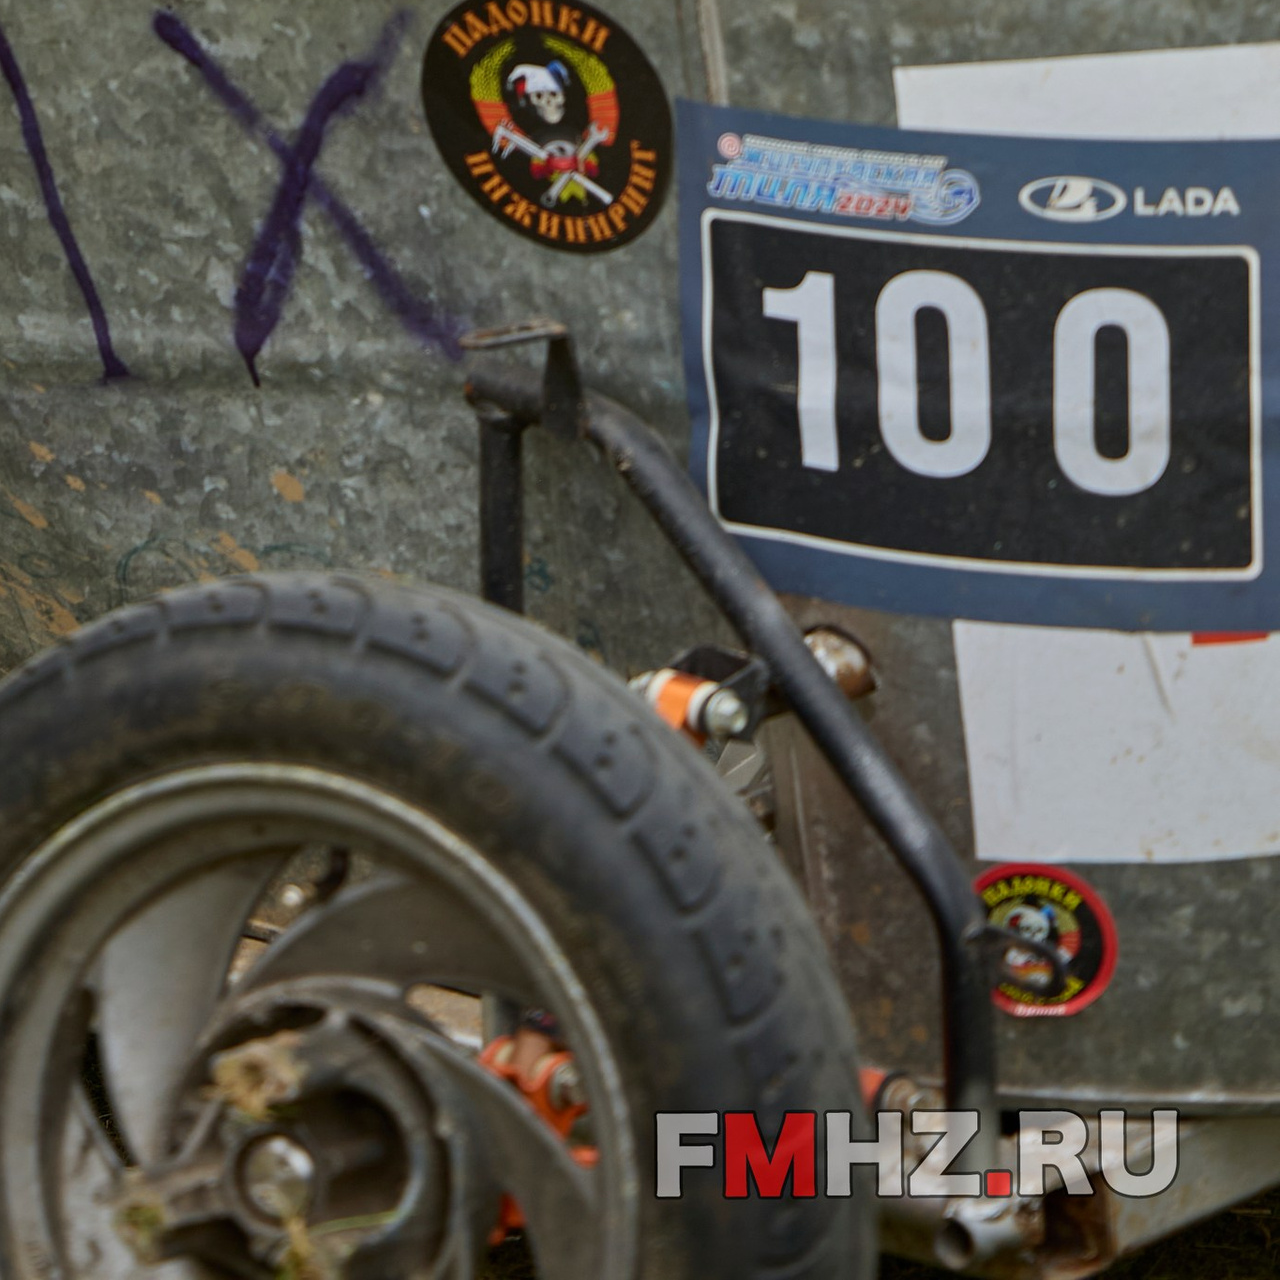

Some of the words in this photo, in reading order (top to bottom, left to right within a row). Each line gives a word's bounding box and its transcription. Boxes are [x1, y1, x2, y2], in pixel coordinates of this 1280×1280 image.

[464, 139, 658, 244] ИНЖИНИРИНГ
[836, 191, 913, 222] 2024
[1134, 185, 1241, 218] LADA
